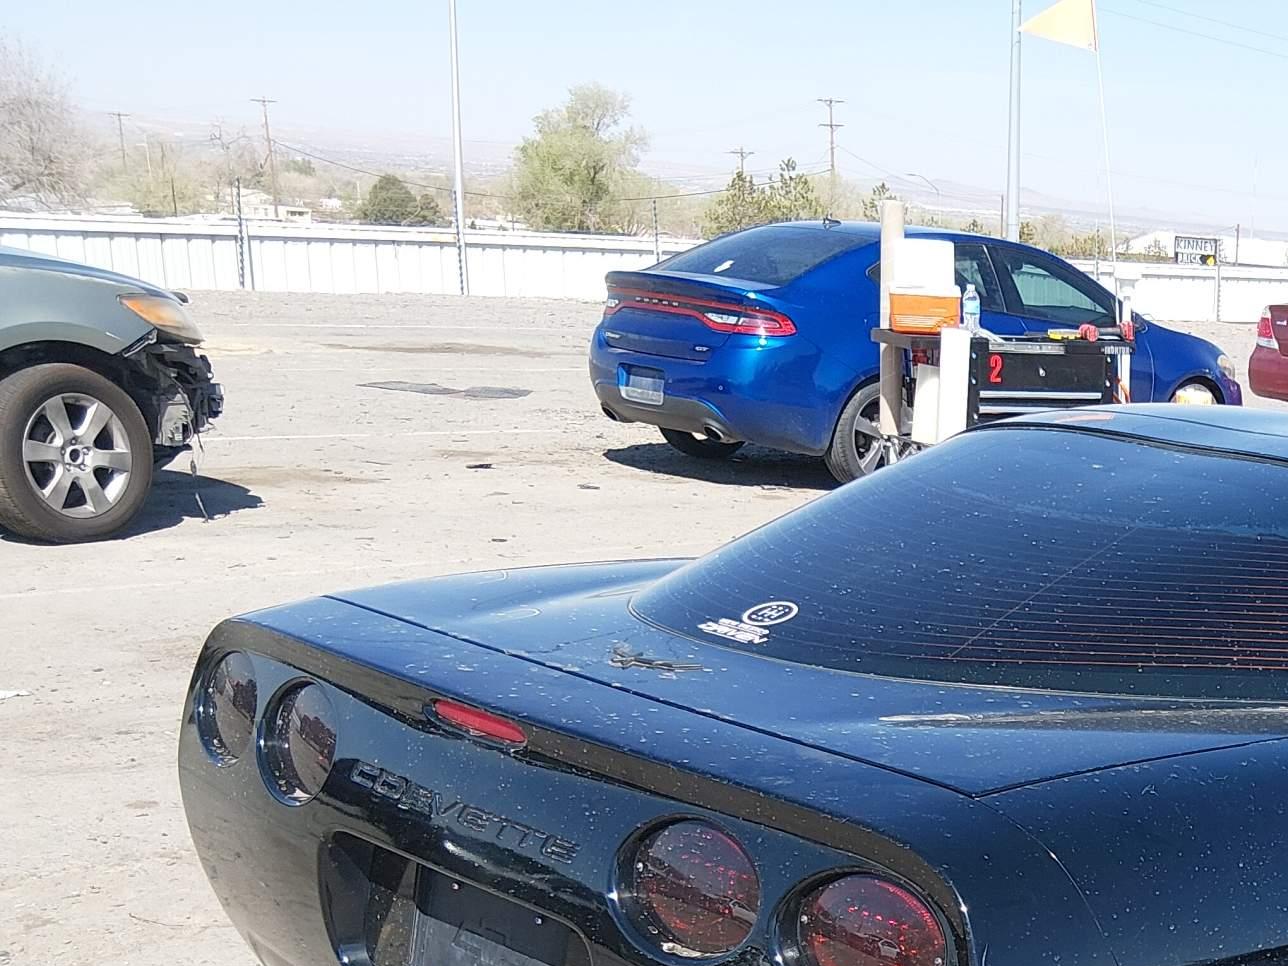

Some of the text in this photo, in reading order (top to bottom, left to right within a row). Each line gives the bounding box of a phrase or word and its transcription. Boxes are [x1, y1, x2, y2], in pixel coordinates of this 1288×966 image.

[1176, 239, 1216, 252] KINNEY
[989, 355, 1002, 383] 2
[350, 759, 582, 865] CORVETTE
